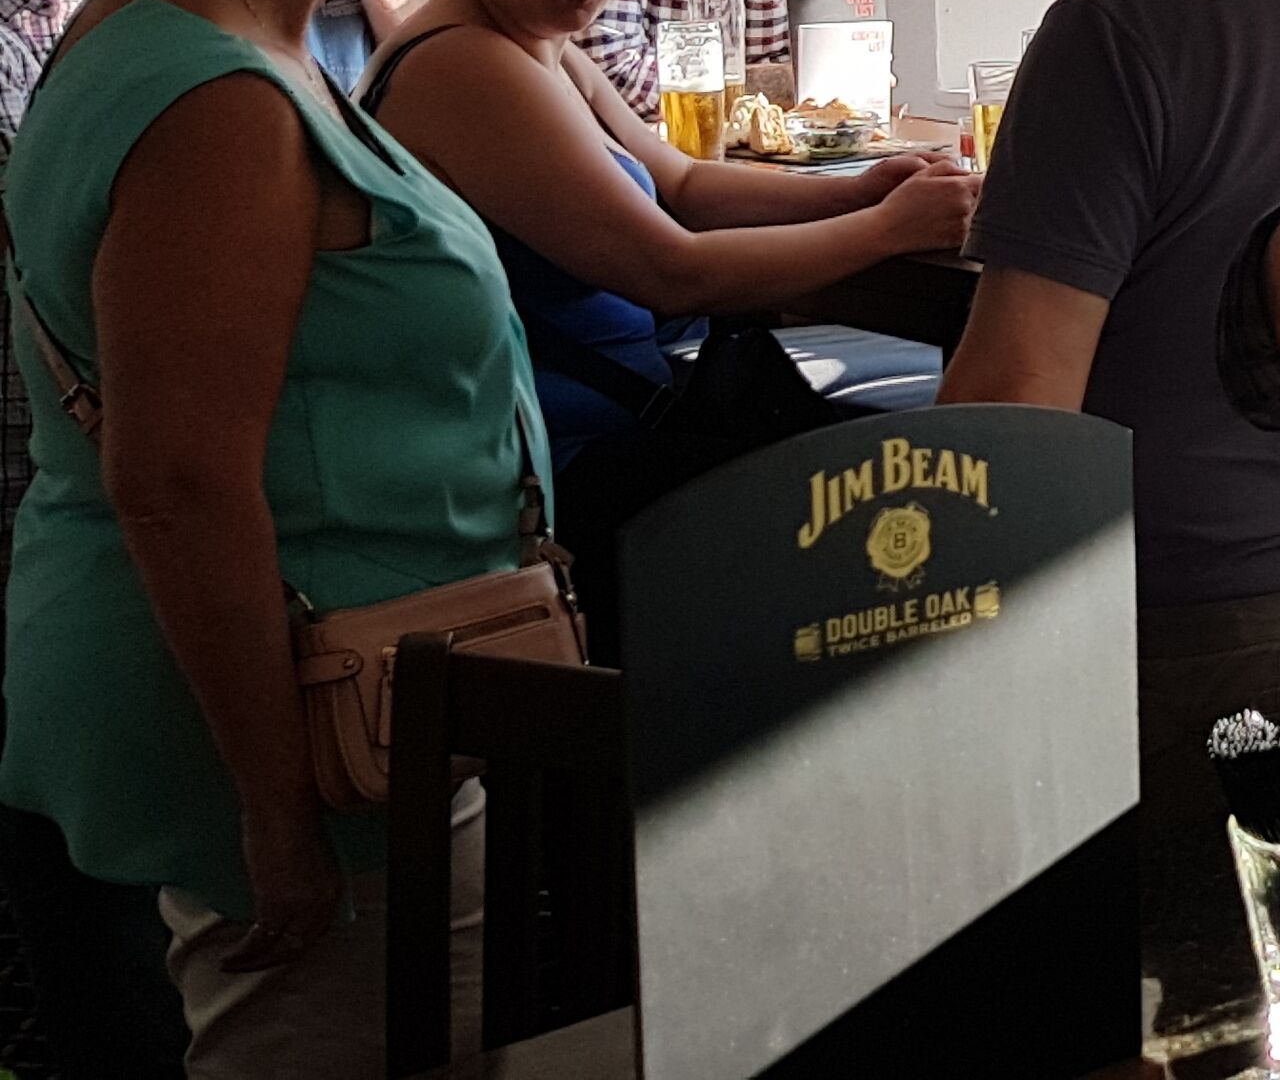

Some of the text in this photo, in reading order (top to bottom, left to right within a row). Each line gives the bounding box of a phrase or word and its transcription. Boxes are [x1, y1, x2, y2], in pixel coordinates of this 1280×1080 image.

[854, 4, 876, 18] LIST
[797, 436, 989, 549] JIM BEAM
[826, 585, 971, 643] DOUBLE OAK
[828, 611, 972, 657] TWICE BARRELED
